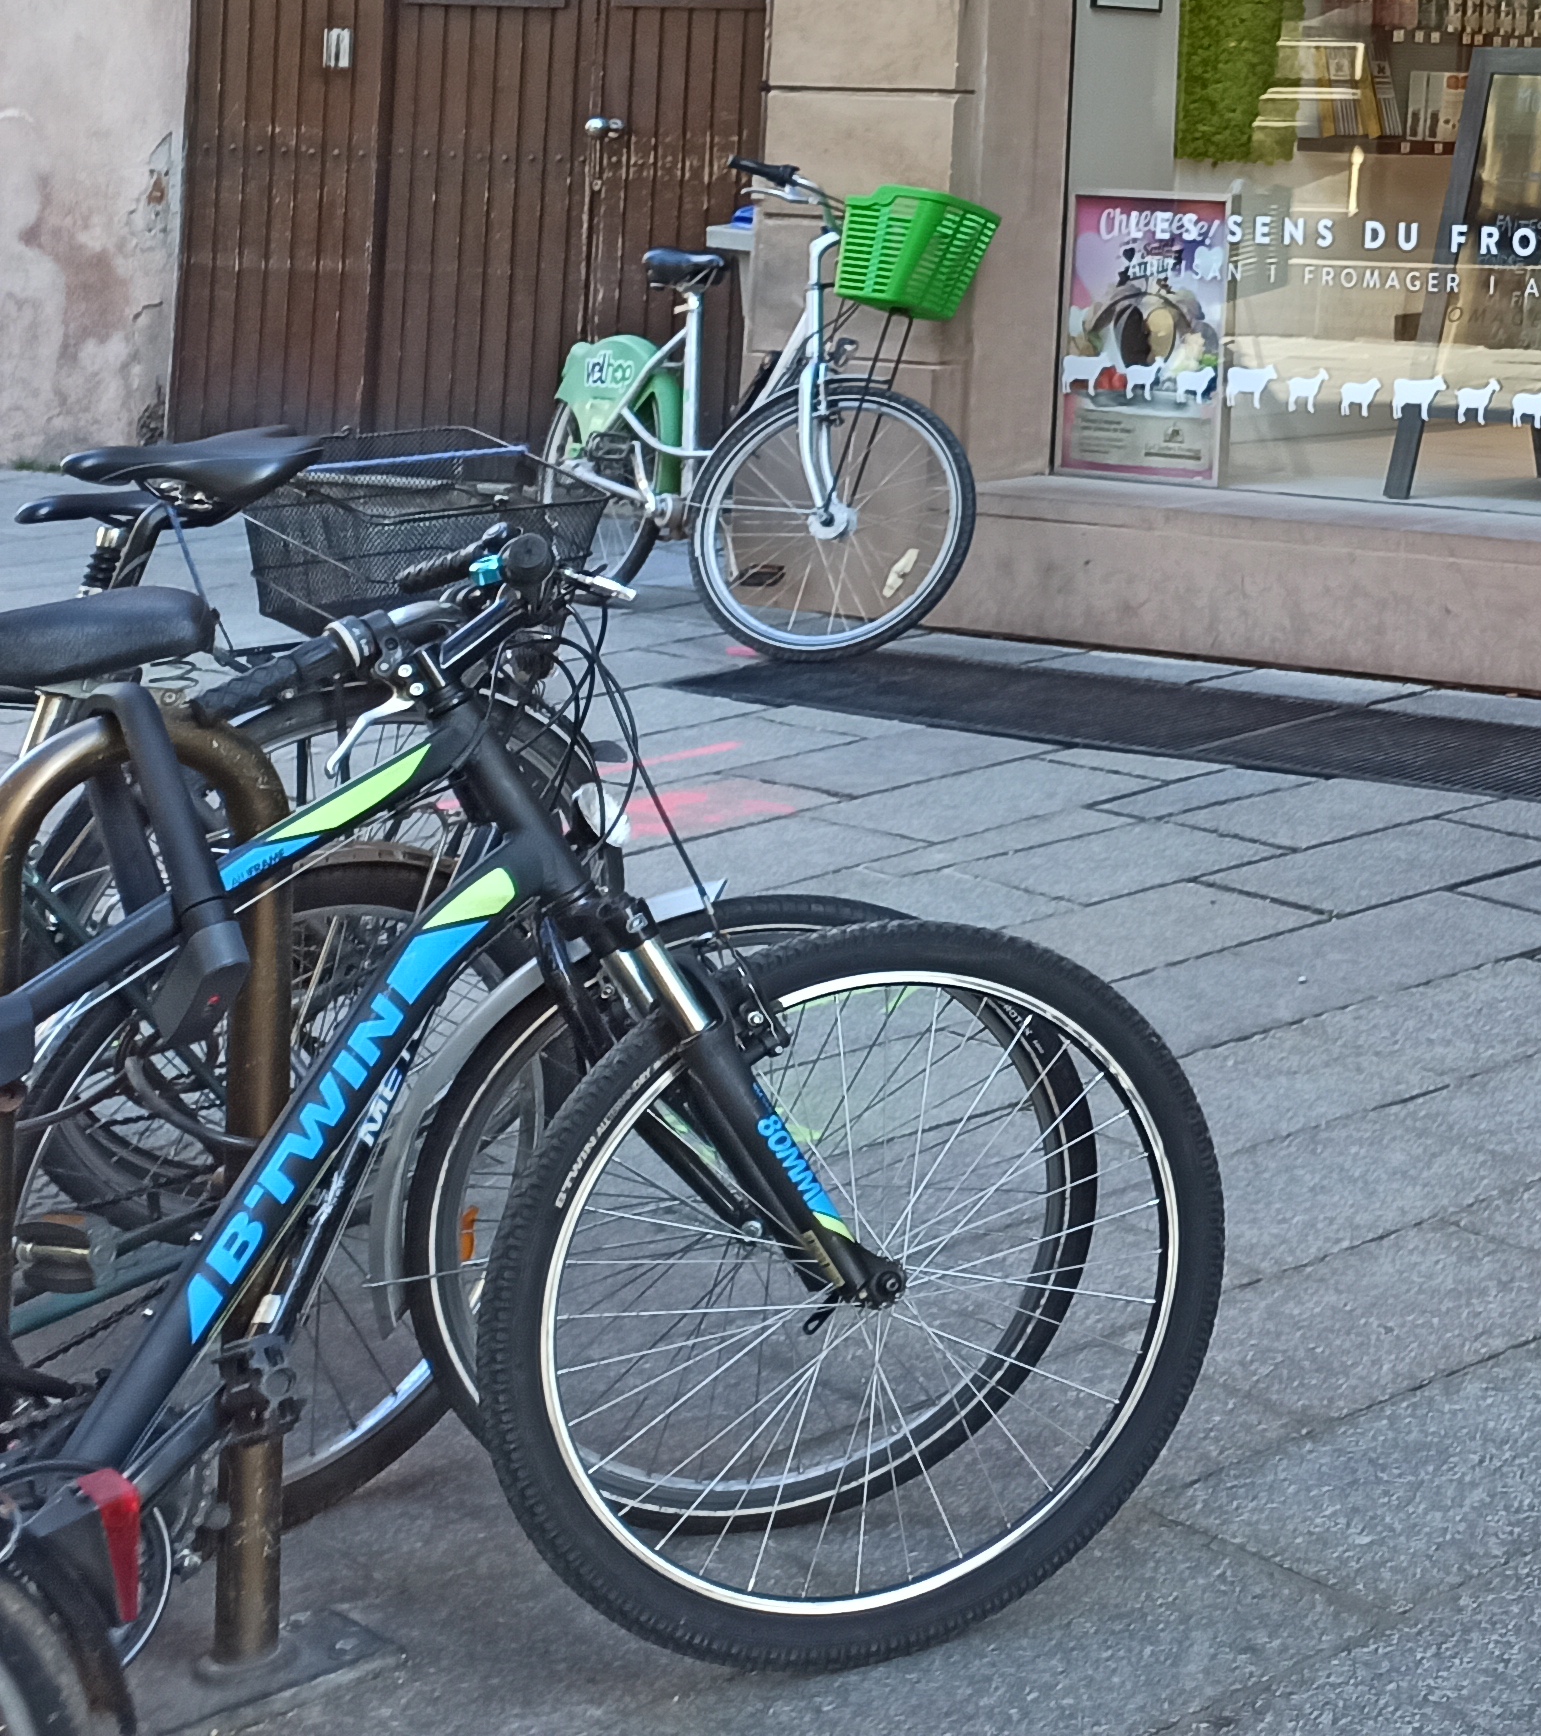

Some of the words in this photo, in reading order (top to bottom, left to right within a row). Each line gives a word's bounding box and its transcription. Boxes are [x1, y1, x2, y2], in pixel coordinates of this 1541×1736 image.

[1129, 210, 1200, 241] LES
[1226, 214, 1334, 248] SENS
[1364, 220, 1419, 252] DU
[1303, 266, 1460, 294] FROMAGER
